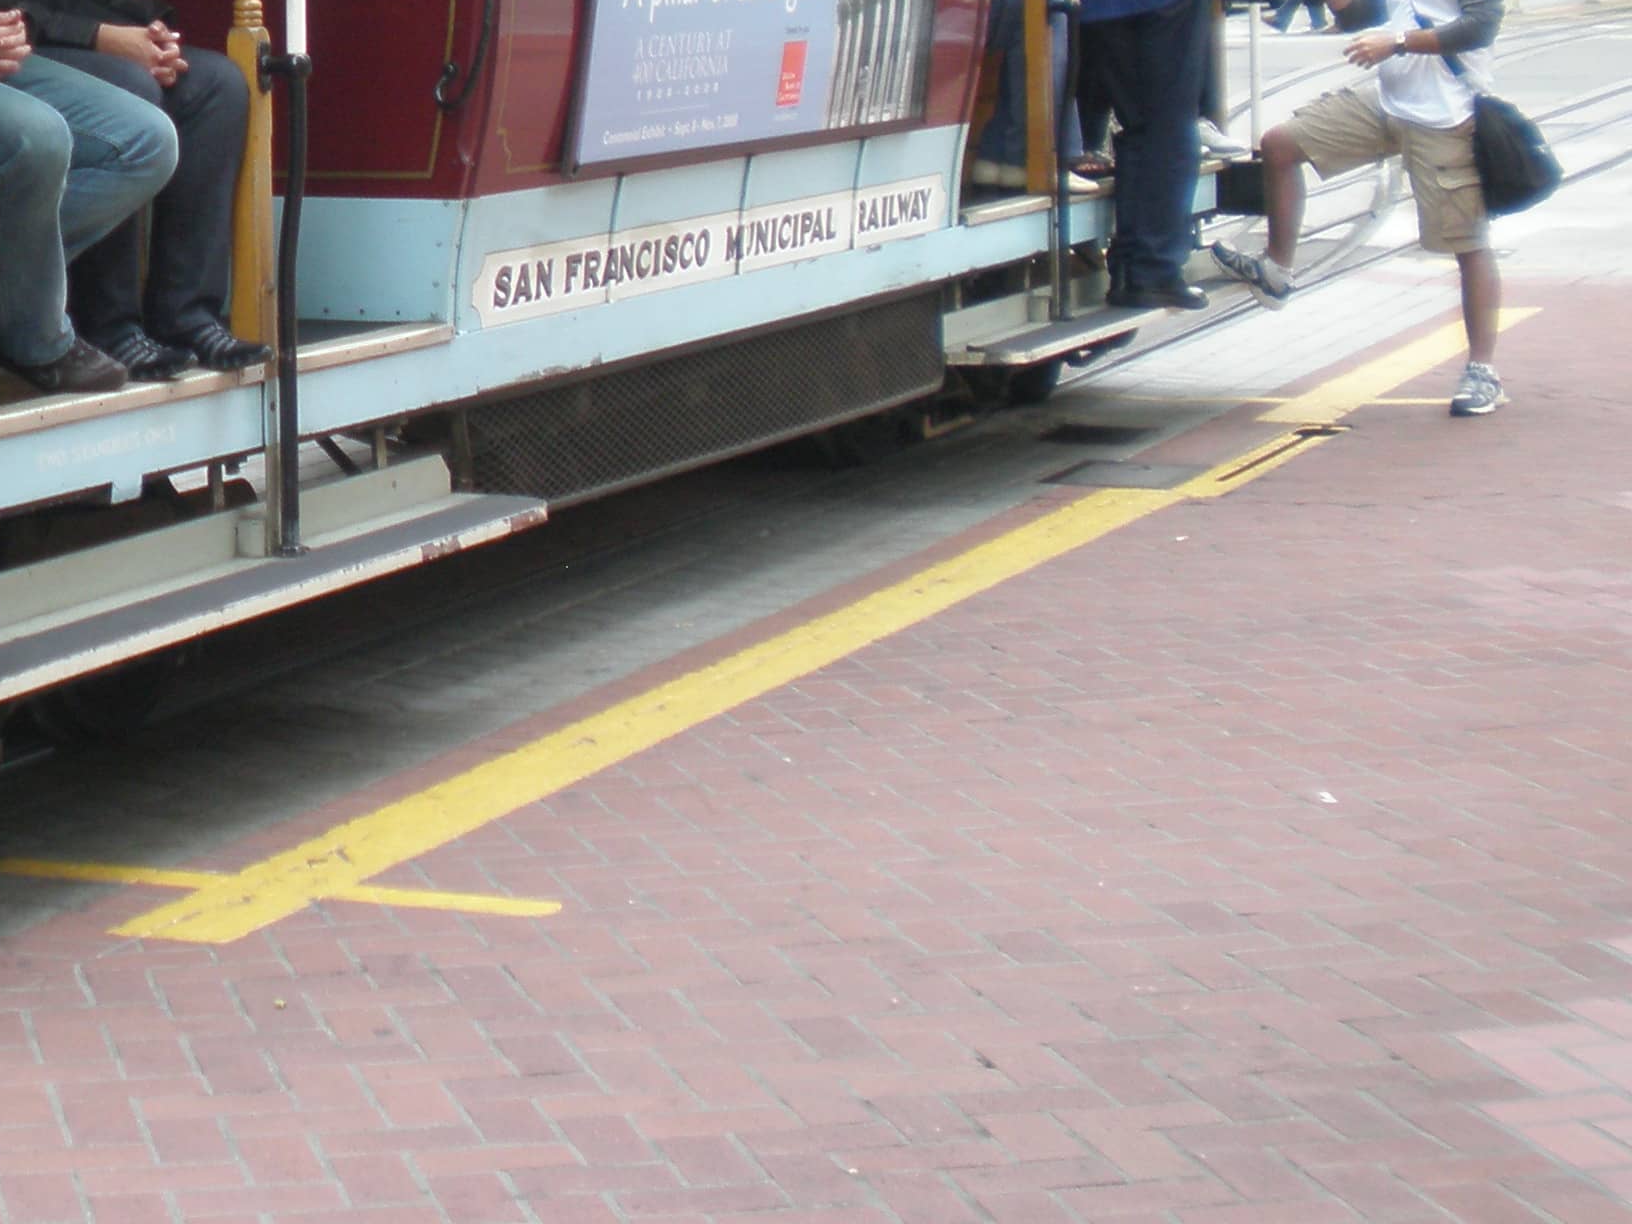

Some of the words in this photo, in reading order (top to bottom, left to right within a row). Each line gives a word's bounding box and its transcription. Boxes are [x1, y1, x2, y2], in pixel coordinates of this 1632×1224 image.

[635, 39, 644, 60] A
[647, 32, 712, 58] CENTURY
[716, 29, 734, 51] AT
[655, 55, 729, 83] CALIFORNIA
[493, 258, 555, 310] SAN
[564, 229, 712, 293] FRANCISCO
[725, 208, 836, 262] MUNICIPAL
[857, 187, 934, 235] RAILWAY
